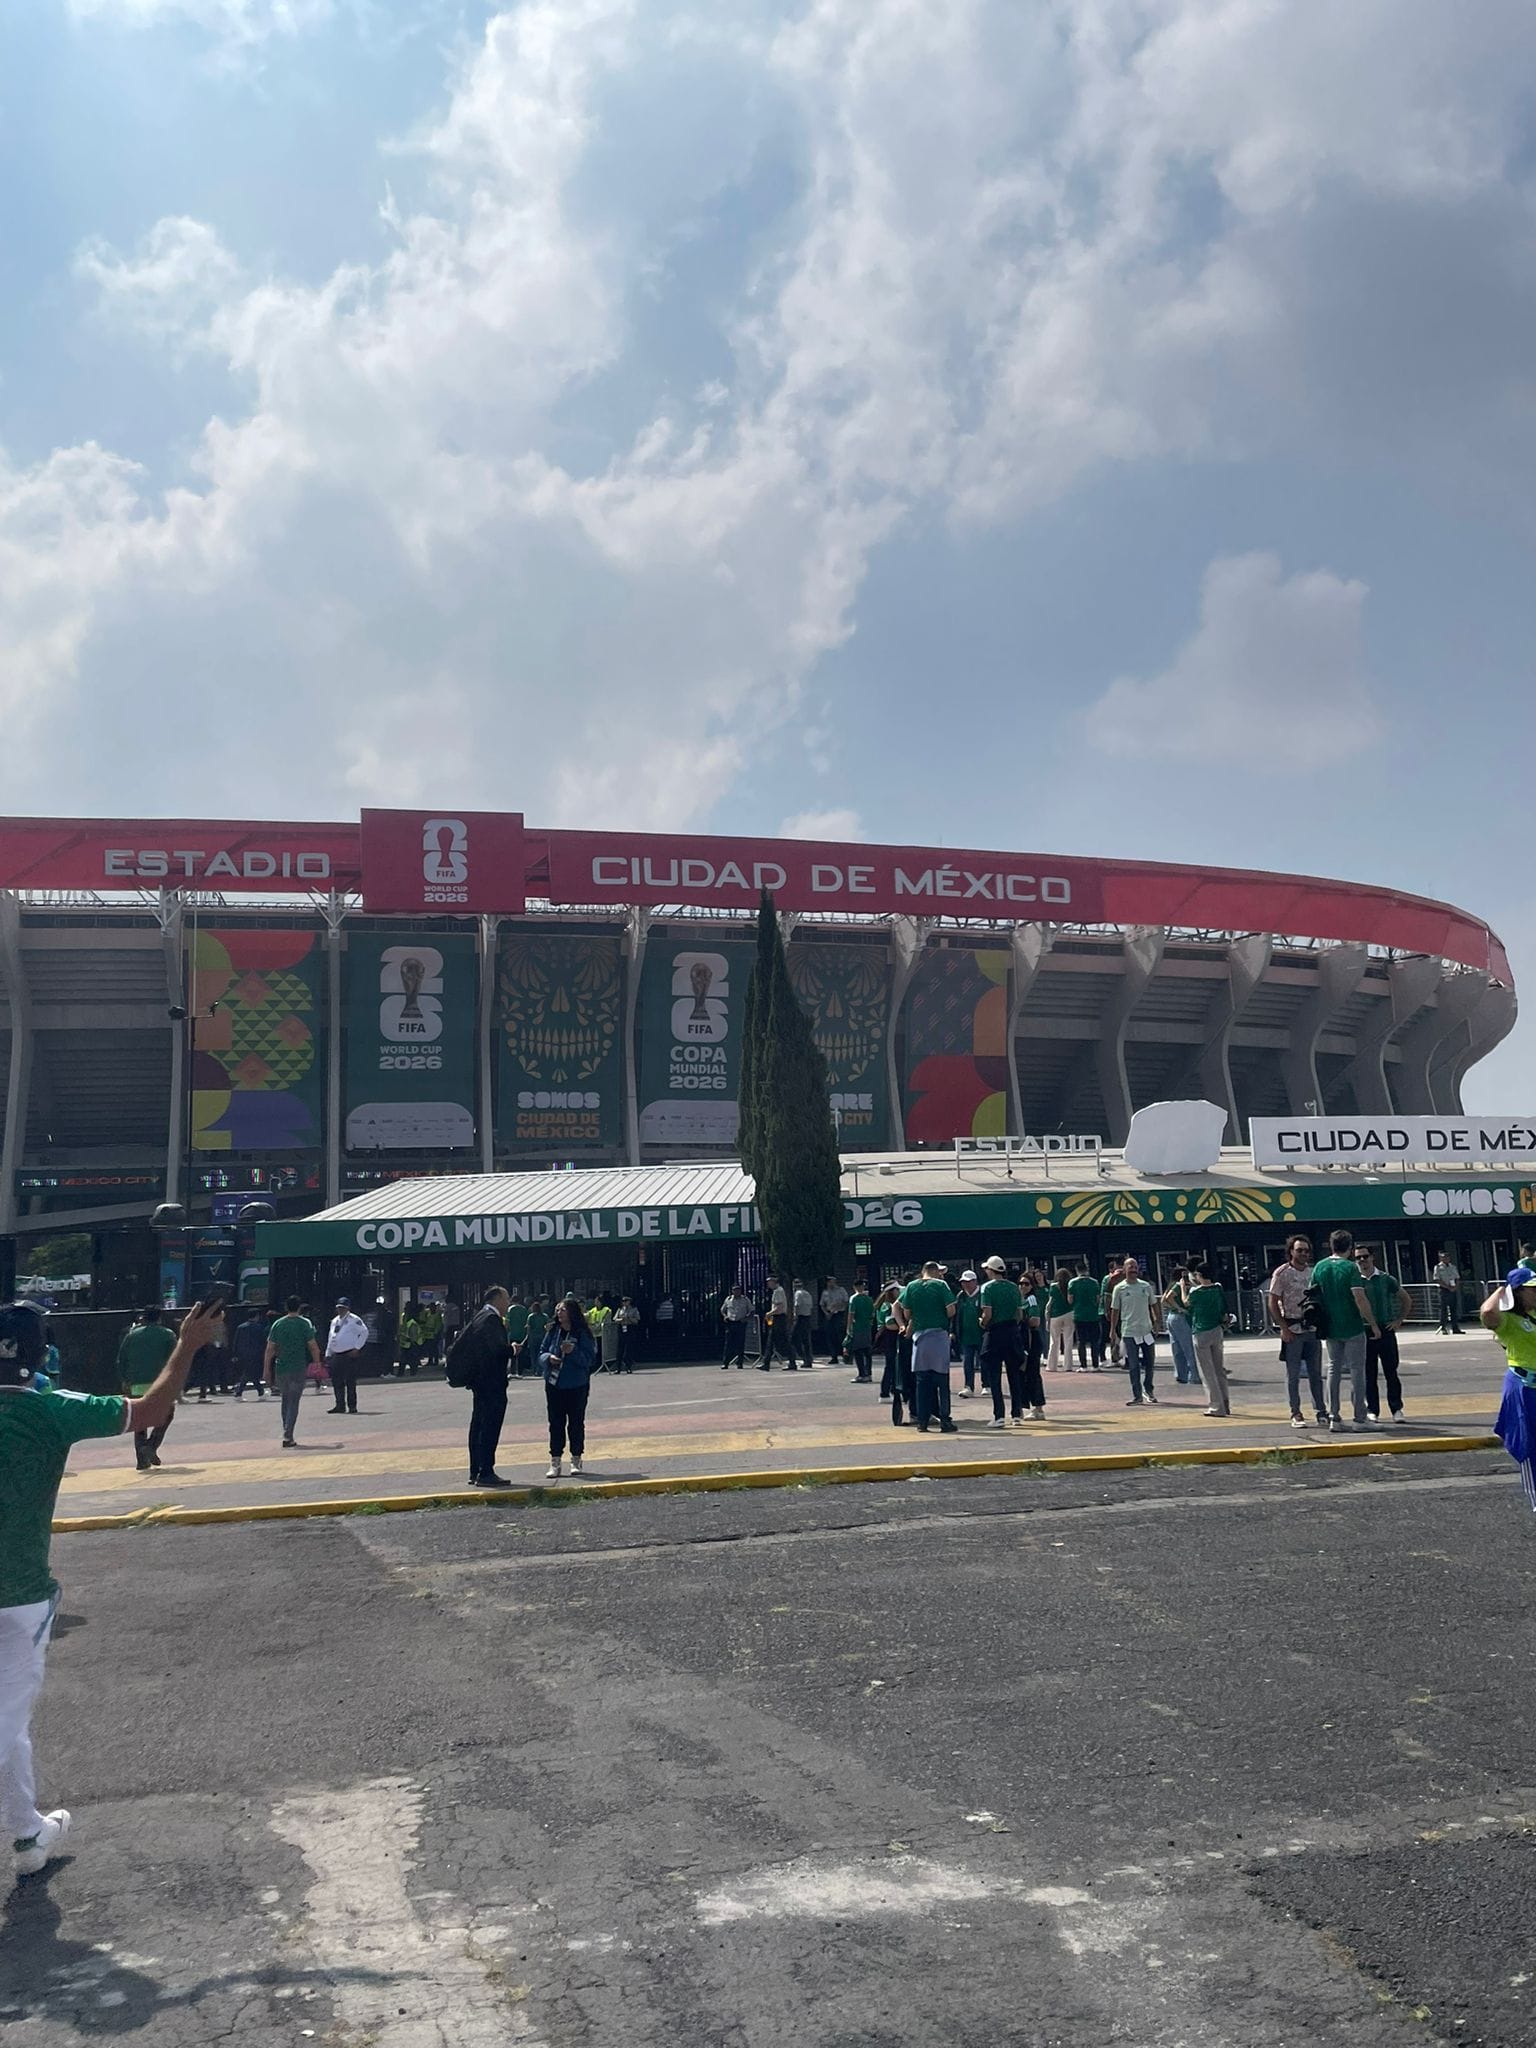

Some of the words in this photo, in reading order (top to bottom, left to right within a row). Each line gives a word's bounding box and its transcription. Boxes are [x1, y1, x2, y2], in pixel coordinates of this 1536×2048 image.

[104, 849, 331, 879] ESTADIO
[591, 856, 787, 890] CIUDAD
[811, 864, 876, 893] DE
[894, 863, 1071, 904] MÉXICO
[423, 893, 468, 903] 2026
[398, 1023, 426, 1033] FIFA
[687, 1024, 713, 1035] FIFA
[379, 1045, 419, 1054] WORLD
[420, 1045, 442, 1054] CUP
[670, 1046, 727, 1063] COPA
[379, 1056, 442, 1070] 2026
[669, 1064, 727, 1075] MUNDIAL
[669, 1076, 727, 1090] 2026
[517, 1091, 601, 1109] SOMOS
[516, 1112, 578, 1125] CIUDAD
[580, 1112, 601, 1125] DE
[844, 1112, 873, 1126] CITY
[952, 1134, 1102, 1154] ESTADIO
[1278, 1129, 1409, 1153] CIUDAD
[1426, 1129, 1470, 1151] DE
[1402, 1188, 1516, 1216] SOMOS
[356, 1220, 448, 1250] COPA
[455, 1211, 610, 1246] MUNDIAL
[617, 1209, 661, 1238] DE
[669, 1207, 713, 1236] LA
[36, 1277, 81, 1292] Rexona
